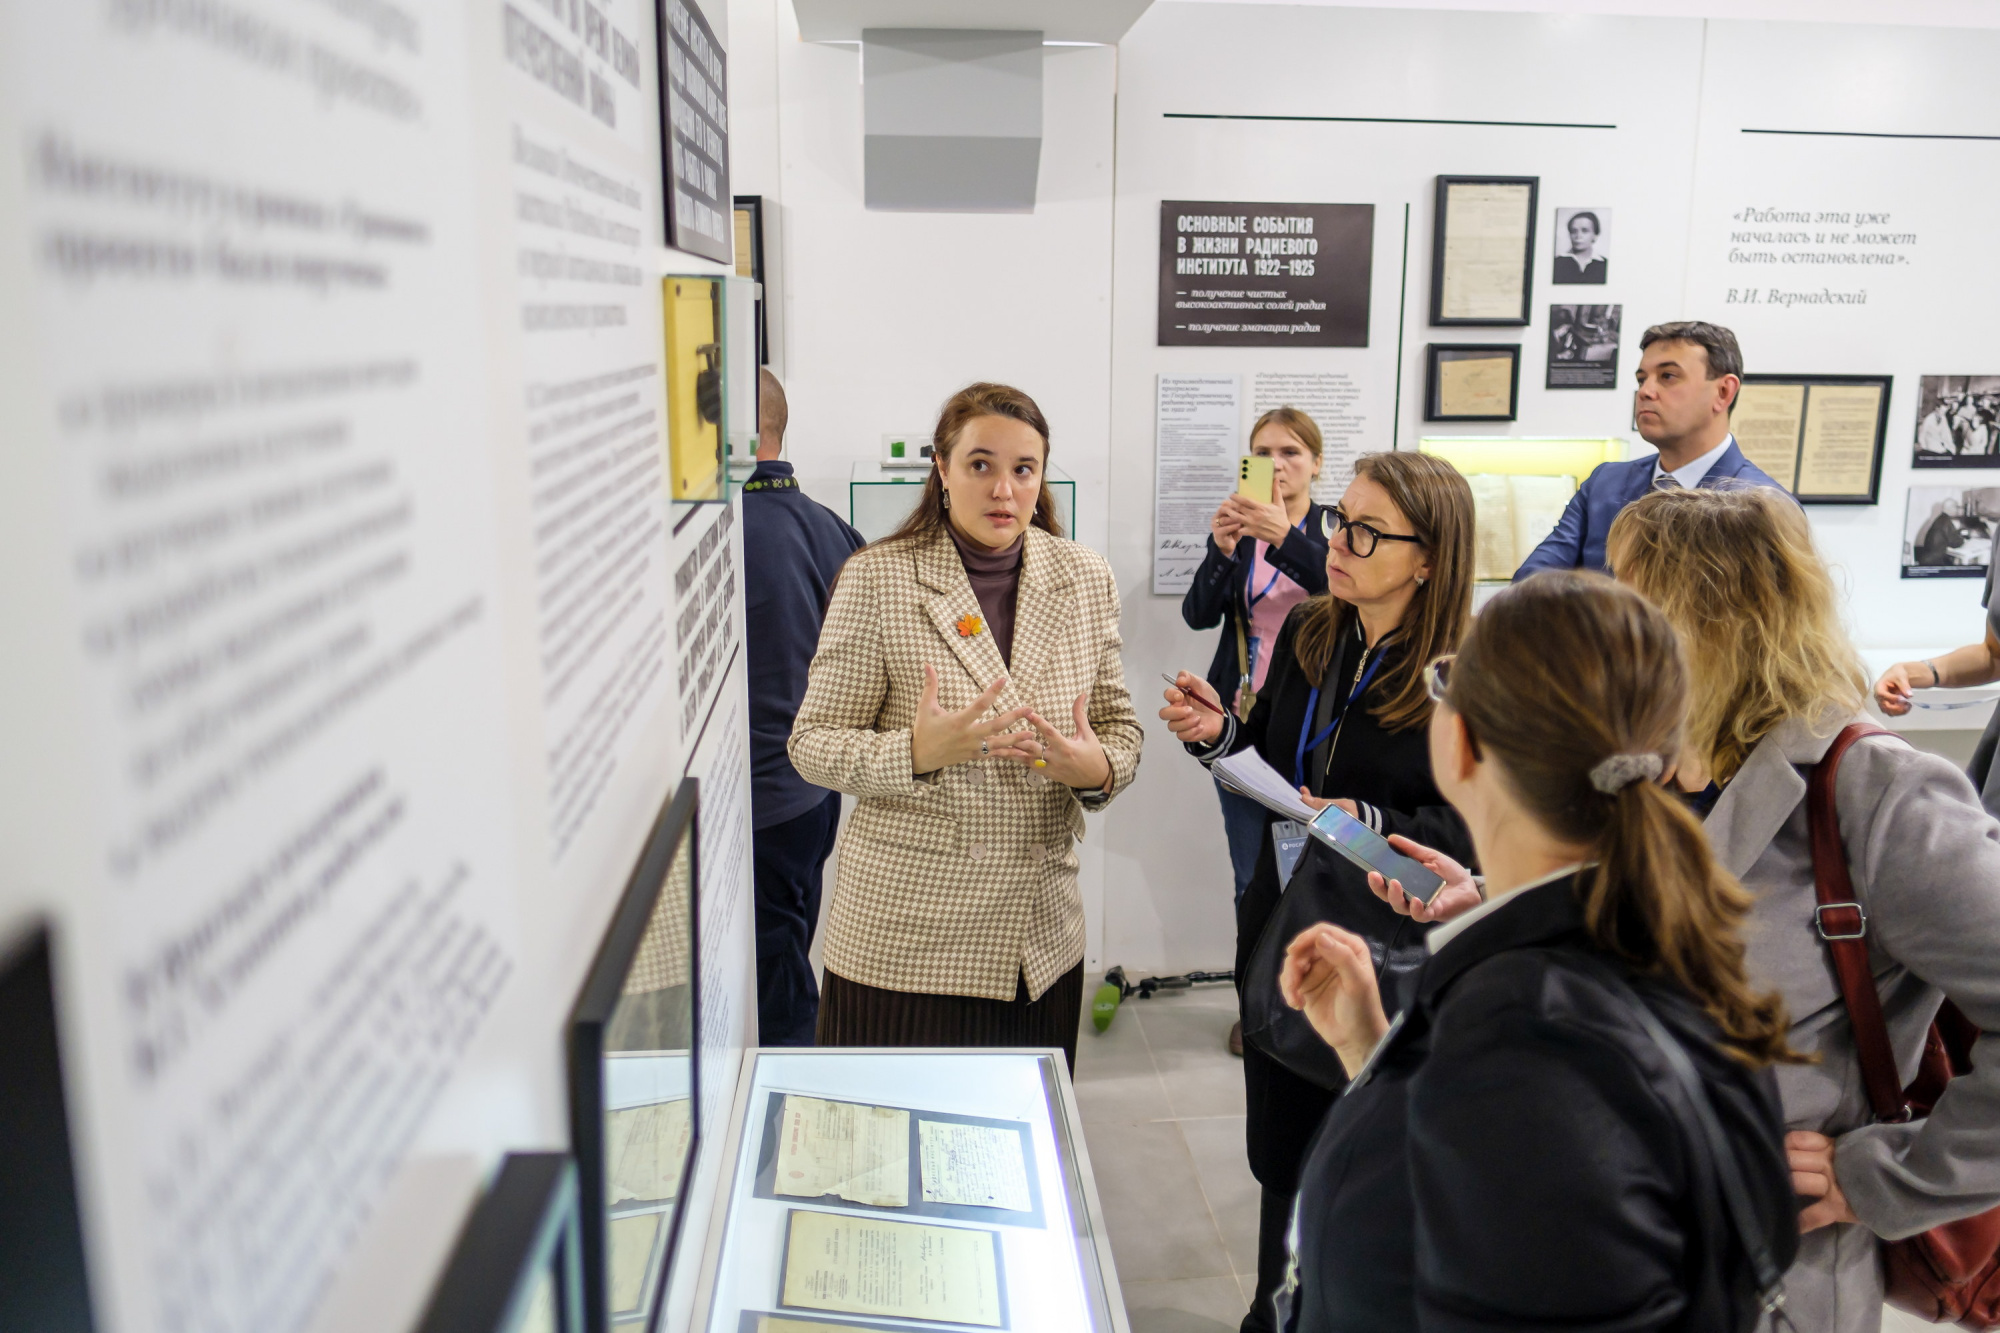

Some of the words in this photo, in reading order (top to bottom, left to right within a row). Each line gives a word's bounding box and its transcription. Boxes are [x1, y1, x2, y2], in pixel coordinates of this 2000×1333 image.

[1177, 215, 1247, 233] ОСНОВНЫЕ
[1253, 216, 1314, 234] СОБЫТИЯ
[1733, 206, 1811, 224] «Работа
[1814, 211, 1851, 224] эта
[1854, 211, 1891, 228] уже
[1177, 236, 1187, 254] В
[1192, 236, 1239, 254] ЖИЗНИ
[1245, 238, 1318, 258] РАДИЕВОГО
[1730, 231, 1811, 245] началась
[1815, 233, 1826, 245] и
[1830, 232, 1850, 245] не
[1852, 233, 1917, 245] может
[1728, 247, 1778, 264] быть
[1781, 251, 1911, 265] остановлена».
[1176, 258, 1249, 276] ИНСТИТУТА
[1191, 289, 1245, 300] получение
[1246, 290, 1287, 299] чистых
[1726, 288, 1762, 304] В.И.
[1766, 287, 1867, 308] Вернадский
[1175, 300, 1264, 310] высокоактивных
[1266, 299, 1294, 310] солей
[1295, 300, 1327, 313] радия
[1188, 323, 1240, 334] получение
[1241, 323, 1290, 334] эманации
[1290, 322, 1321, 335] радия
